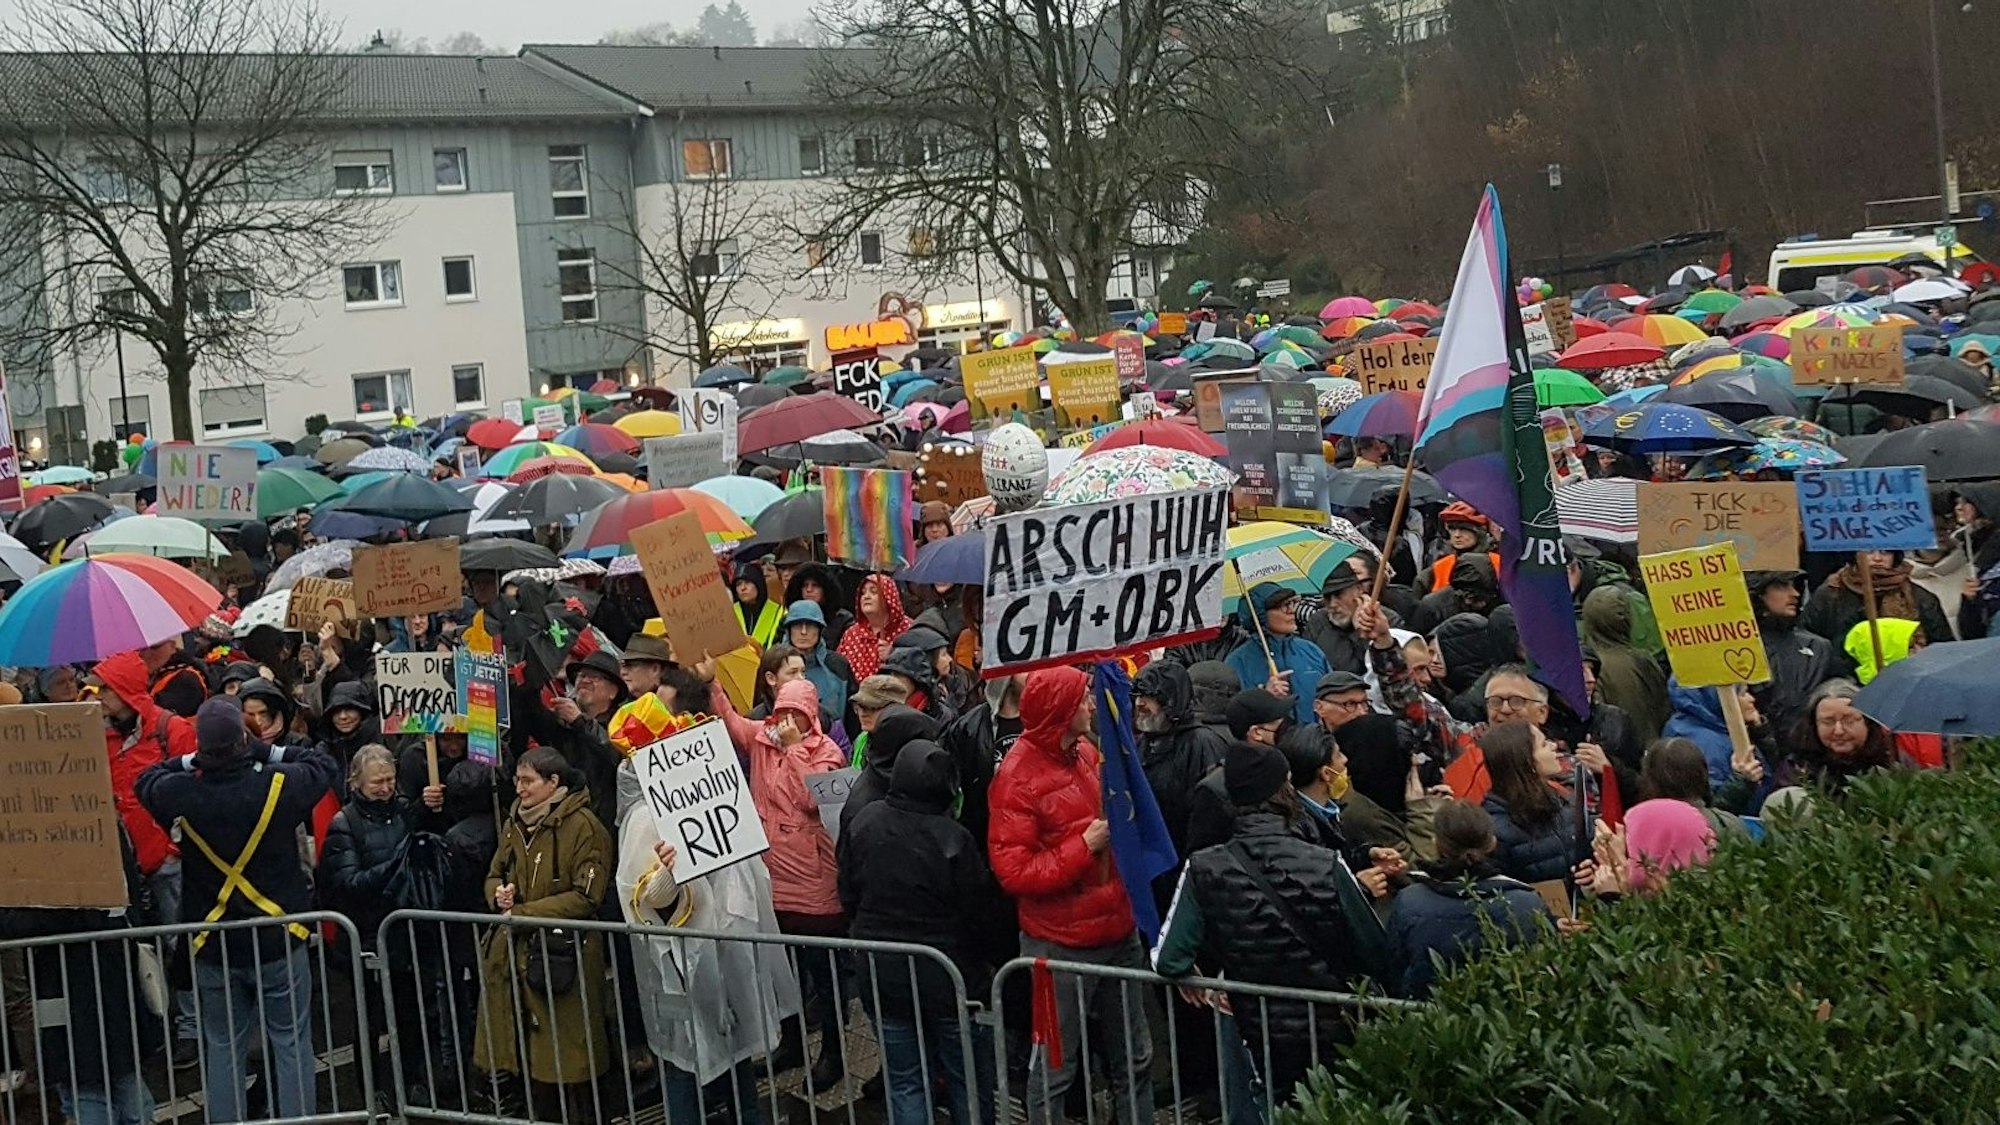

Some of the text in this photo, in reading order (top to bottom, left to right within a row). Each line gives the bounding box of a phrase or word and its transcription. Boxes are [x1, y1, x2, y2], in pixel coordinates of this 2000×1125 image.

[835, 357, 880, 391] FCK
[977, 351, 1032, 369] GRÜN IST
[1060, 364, 1113, 378] GRÜN IST
[170, 453, 221, 479] NIE
[162, 483, 255, 512] WIEDER!
[1703, 512, 1742, 531] DIE
[1810, 510, 1923, 541] SAGE NEIN
[987, 491, 1226, 597] ARSCH HUH
[1646, 554, 1729, 584] HASS IST
[292, 577, 326, 594] AUF
[1671, 588, 1725, 614] KEINE
[1665, 617, 1760, 648] MEINUNG!
[380, 656, 411, 675] FÜR
[474, 664, 502, 682] JETZT!
[34, 714, 82, 742] Hass
[8, 751, 96, 775] euren Zorn
[650, 731, 715, 777] Alexej
[31, 787, 59, 815] Ihr
[648, 763, 739, 819] Nawalny
[678, 804, 740, 867] RIP
